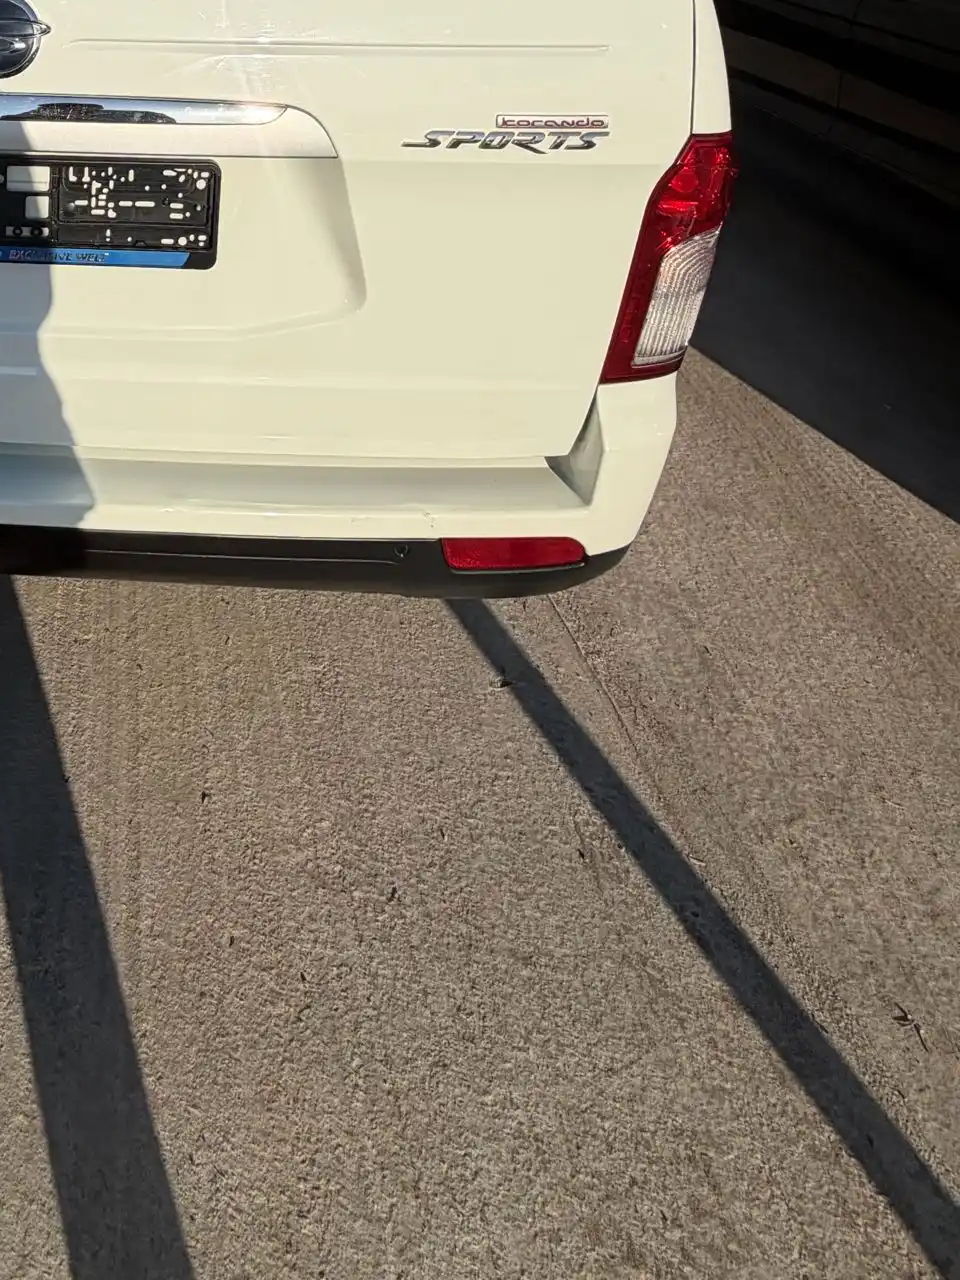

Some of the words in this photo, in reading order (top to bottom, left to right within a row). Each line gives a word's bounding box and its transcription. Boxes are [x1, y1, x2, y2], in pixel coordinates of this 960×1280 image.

[500, 117, 605, 128] korando
[401, 130, 610, 154] SPORTS
[9, 249, 72, 262] EXCIVE
